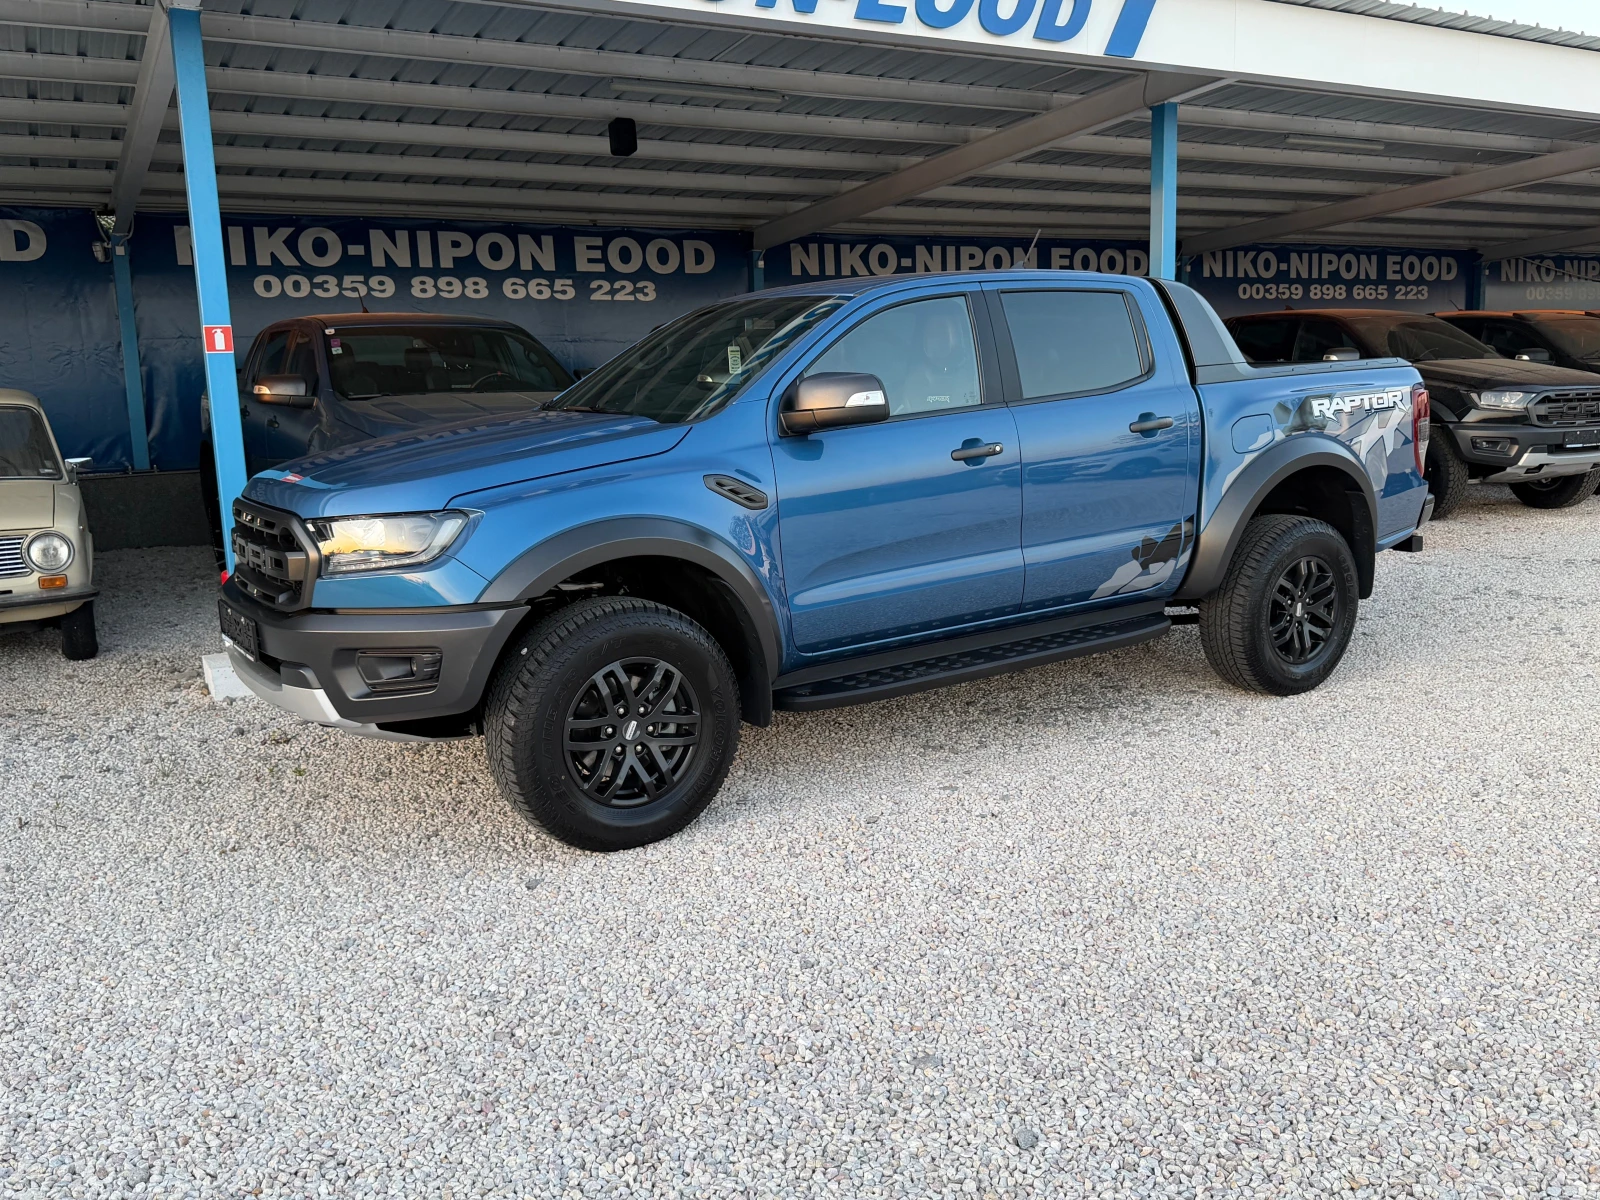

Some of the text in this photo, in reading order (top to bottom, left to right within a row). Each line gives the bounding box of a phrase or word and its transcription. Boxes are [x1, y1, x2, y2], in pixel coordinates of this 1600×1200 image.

[574, 235, 716, 275] EOOD
[790, 242, 1149, 276] NIKO-NIPON EOOD
[1202, 250, 1459, 282] NIKO-NIPON EOOD
[253, 274, 657, 302] 00359 898 665 223
[1238, 282, 1429, 301] 00359 898 665 223
[1311, 391, 1408, 422] RAPTOR
